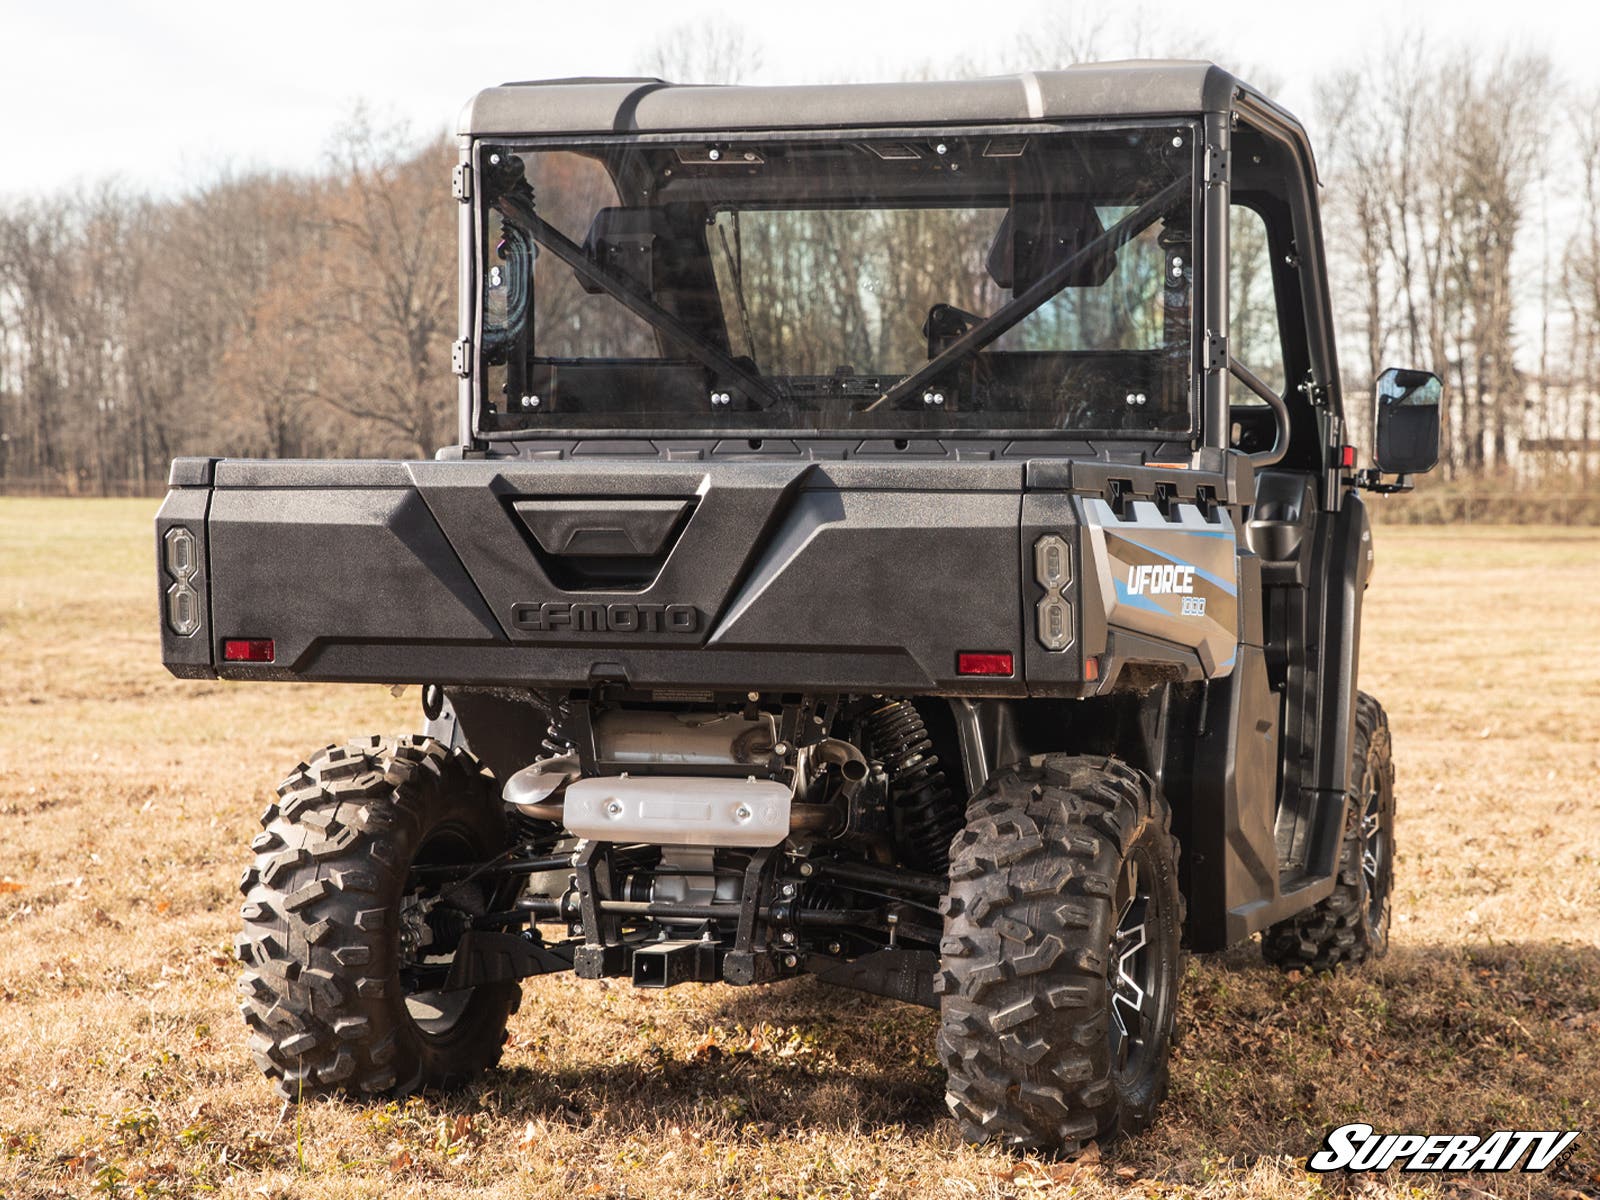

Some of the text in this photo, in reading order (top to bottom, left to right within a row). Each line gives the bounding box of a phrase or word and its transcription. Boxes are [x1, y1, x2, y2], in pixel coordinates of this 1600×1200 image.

[1127, 564, 1195, 595] UFORCE
[511, 602, 697, 633] CFMOTO
[1182, 596, 1206, 616] 1000
